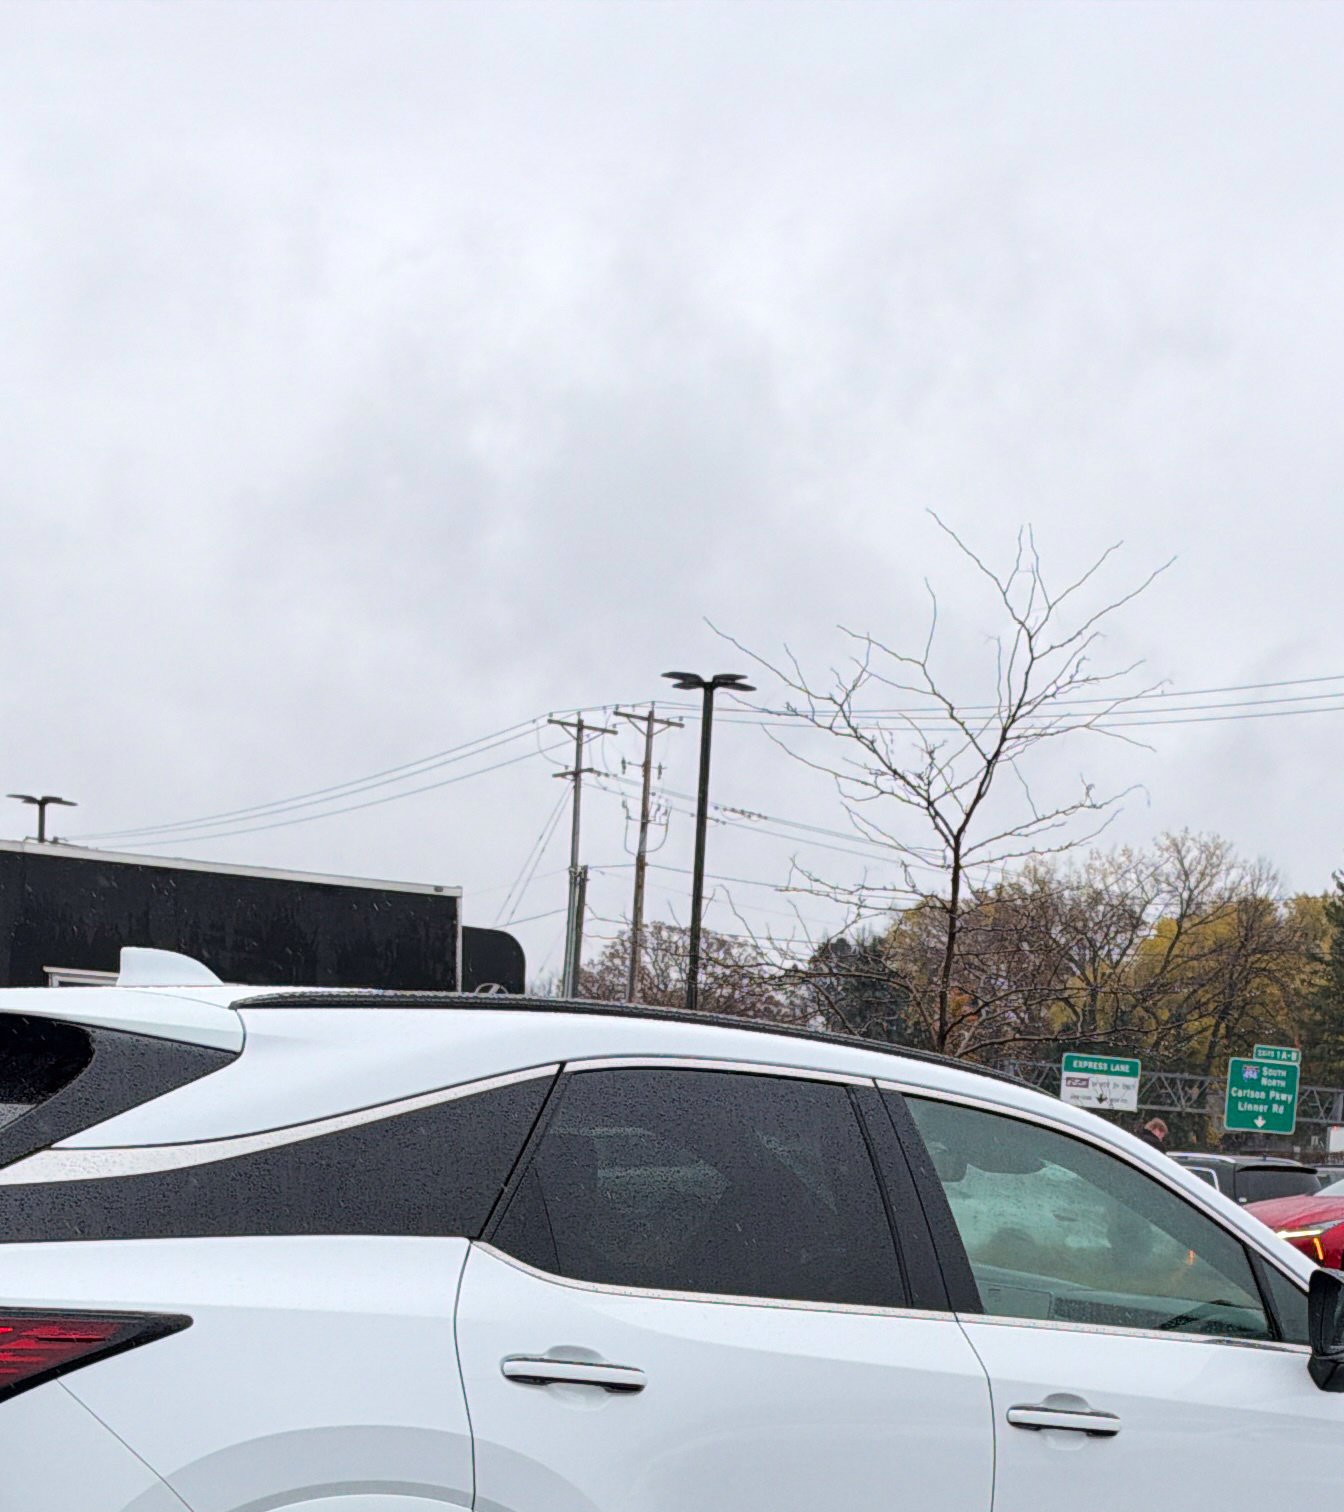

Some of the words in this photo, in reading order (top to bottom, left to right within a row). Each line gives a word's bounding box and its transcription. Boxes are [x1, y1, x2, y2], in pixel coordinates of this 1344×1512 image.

[1072, 1060, 1108, 1071] EXPRESS
[1110, 1063, 1130, 1073] LANE
[1231, 1086, 1266, 1100] Carlson
[1269, 1090, 1293, 1104] Pkwy
[1237, 1101, 1269, 1113] Linner
[1271, 1103, 1285, 1115] Rd
